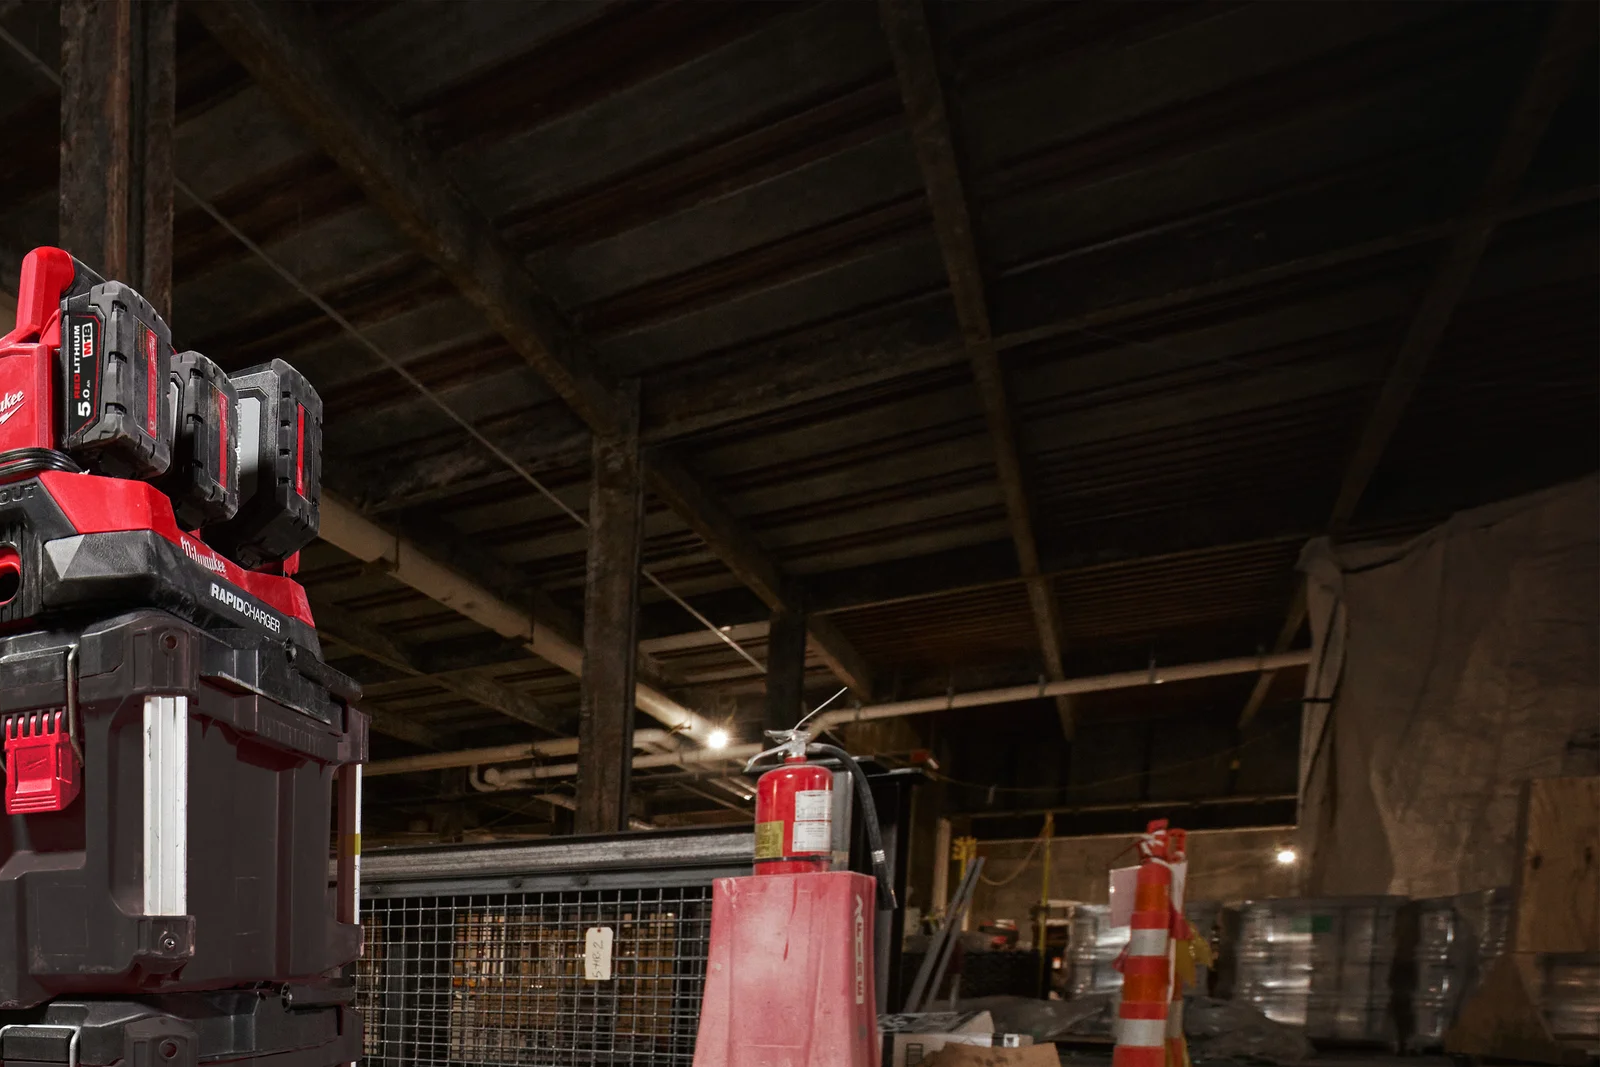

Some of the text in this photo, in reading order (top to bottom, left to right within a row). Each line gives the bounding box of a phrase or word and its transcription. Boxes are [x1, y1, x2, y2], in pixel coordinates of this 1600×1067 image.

[84, 325, 92, 355] M18
[181, 536, 227, 573] Milwaukee
[211, 582, 280, 633] RAPIDCHARGER
